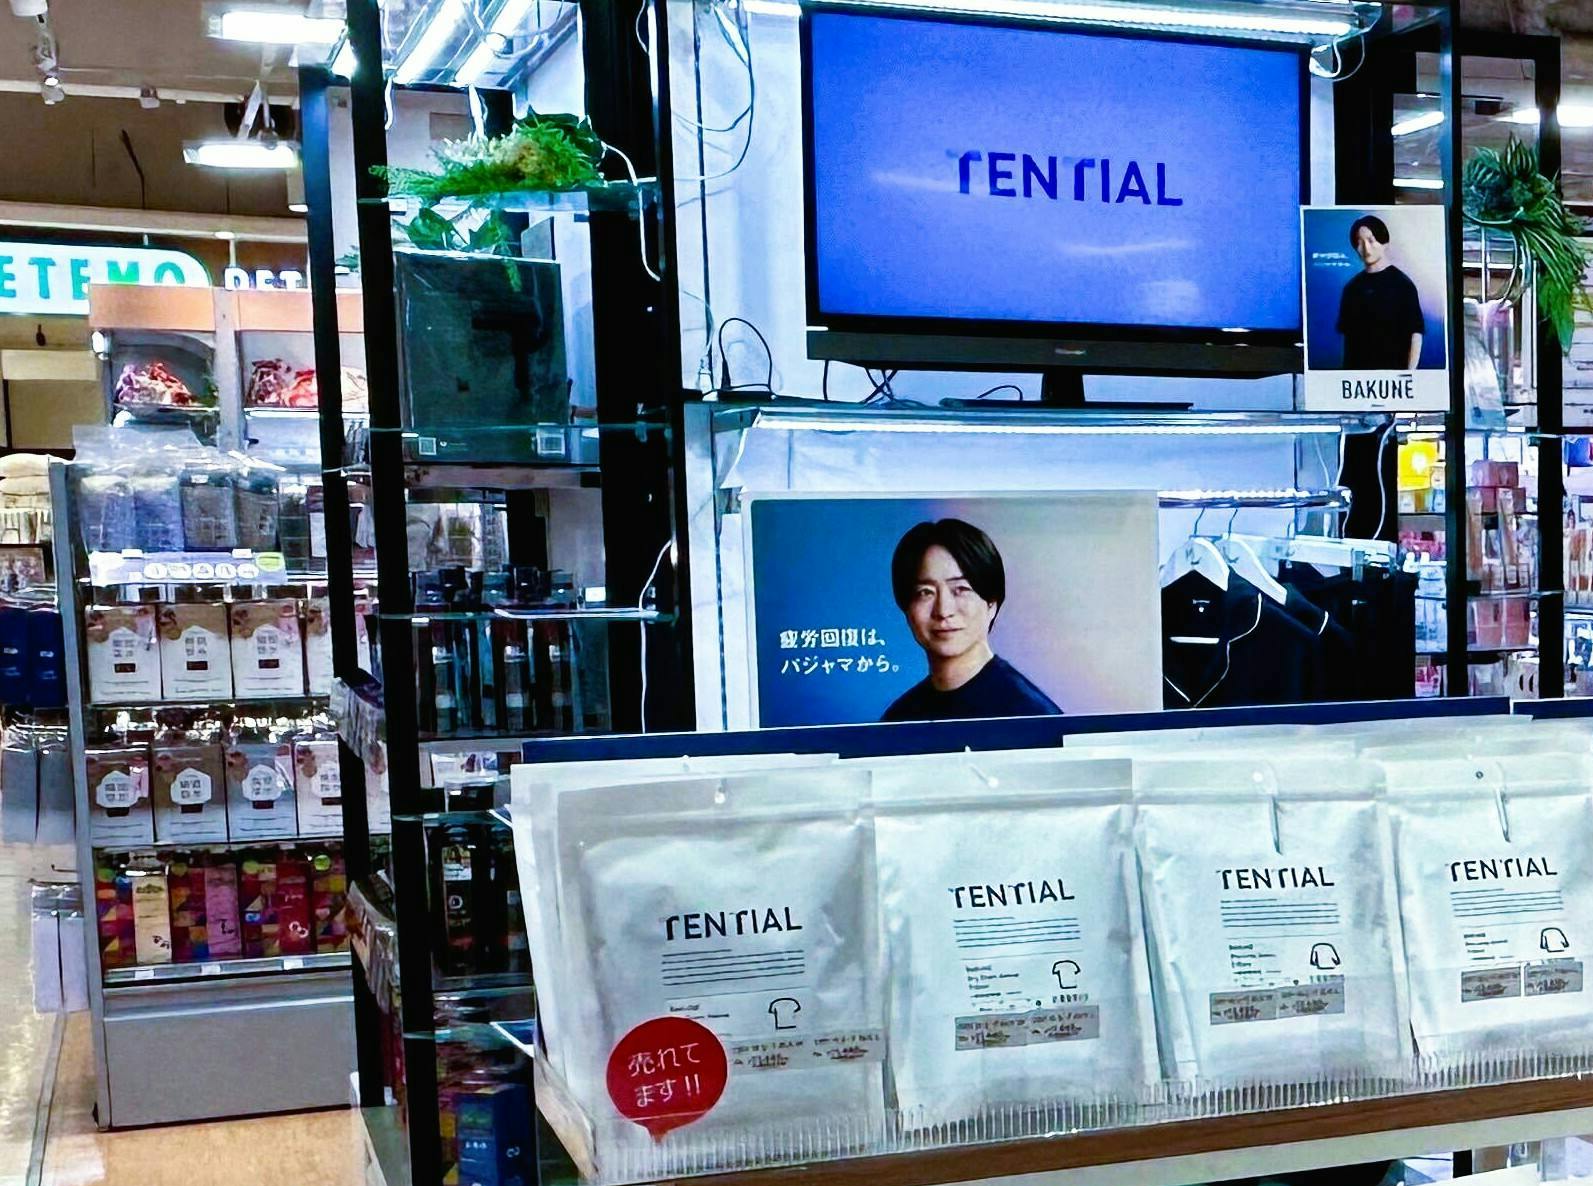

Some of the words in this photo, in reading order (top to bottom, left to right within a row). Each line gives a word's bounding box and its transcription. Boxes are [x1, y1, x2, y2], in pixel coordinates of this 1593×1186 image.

[950, 150, 1184, 207] TENTIAL
[1341, 379, 1415, 400] BAKUNE
[779, 627, 886, 649] 疲労回復は、
[780, 654, 900, 675] パジャマから。
[1218, 866, 1335, 891] TENTIAL
[1450, 856, 1559, 883] TENTIAL
[948, 878, 1076, 909] TENTIAL
[664, 906, 803, 942] TENTIAL
[628, 1042, 701, 1078] 売れて
